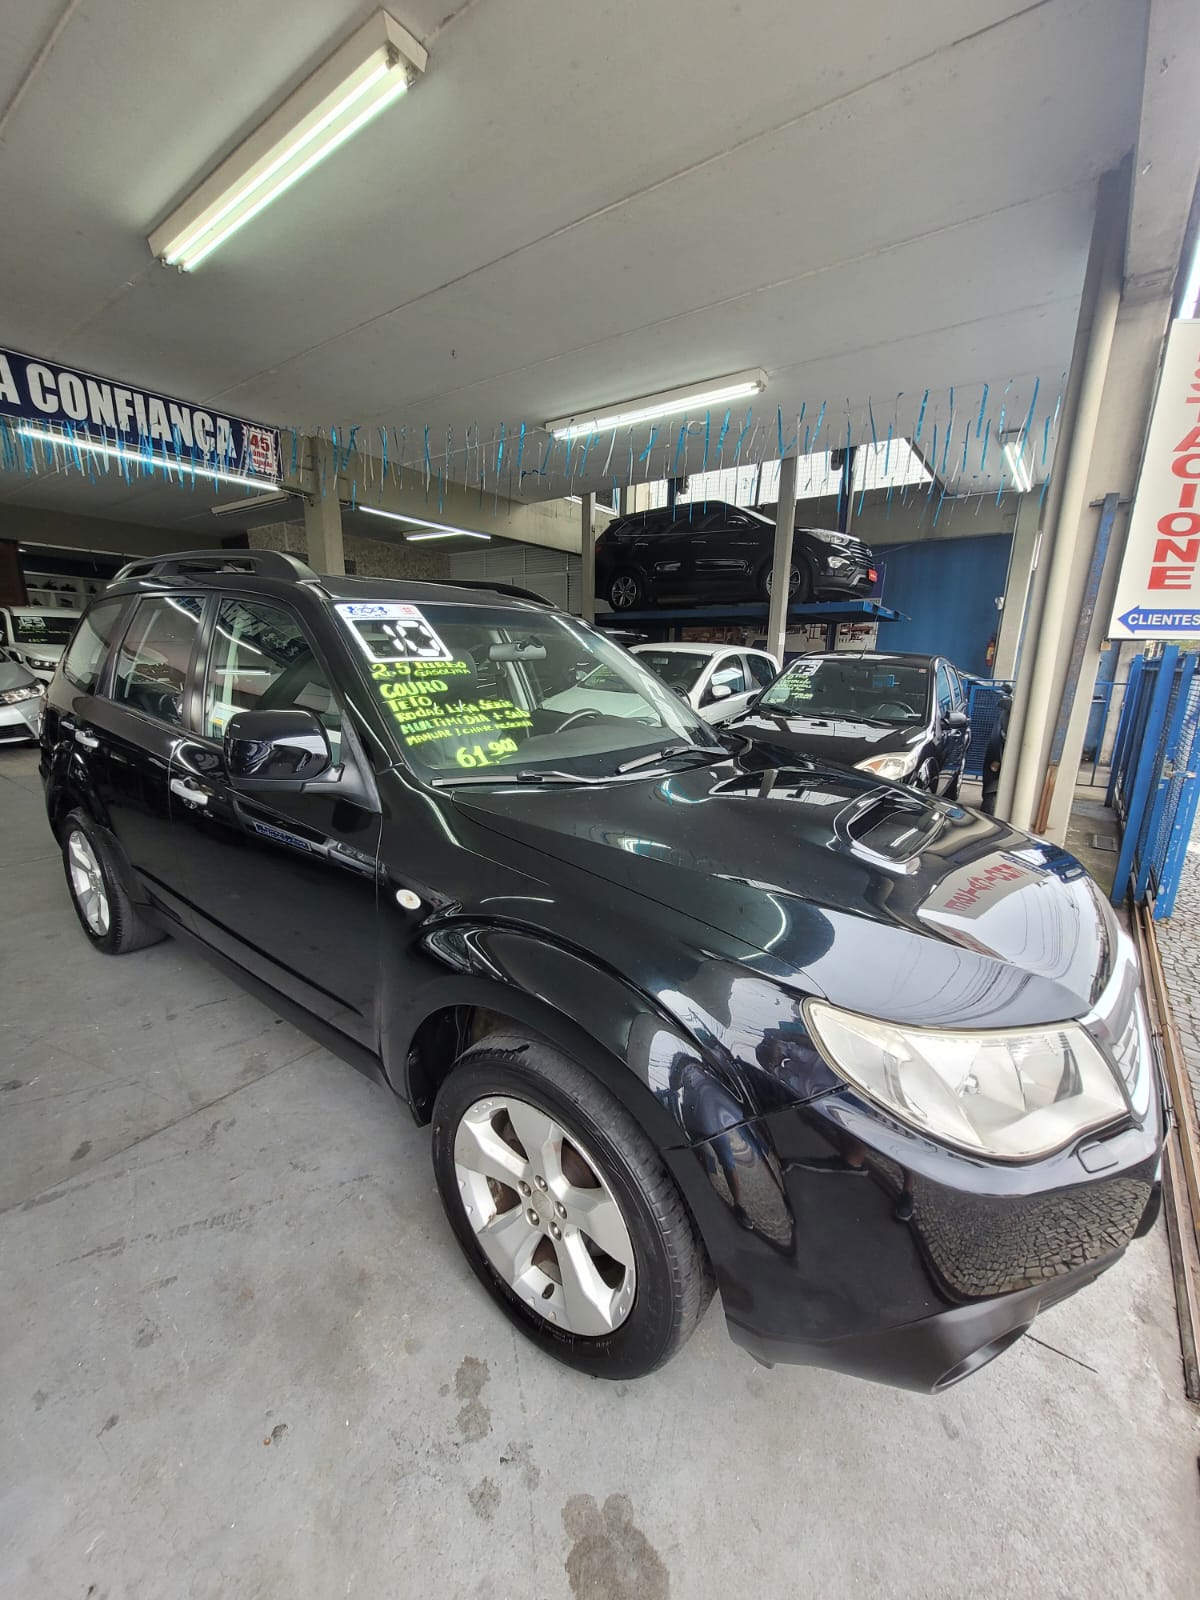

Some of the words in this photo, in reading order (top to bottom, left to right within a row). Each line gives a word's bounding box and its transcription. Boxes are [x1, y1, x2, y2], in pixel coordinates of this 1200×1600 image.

[26, 363, 238, 459] CONFIANÇA
[250, 434, 270, 452] 45
[1127, 613, 1200, 626] CLIENTES
[382, 620, 441, 657] 10
[379, 679, 449, 699] COURO
[384, 695, 433, 712] TETO
